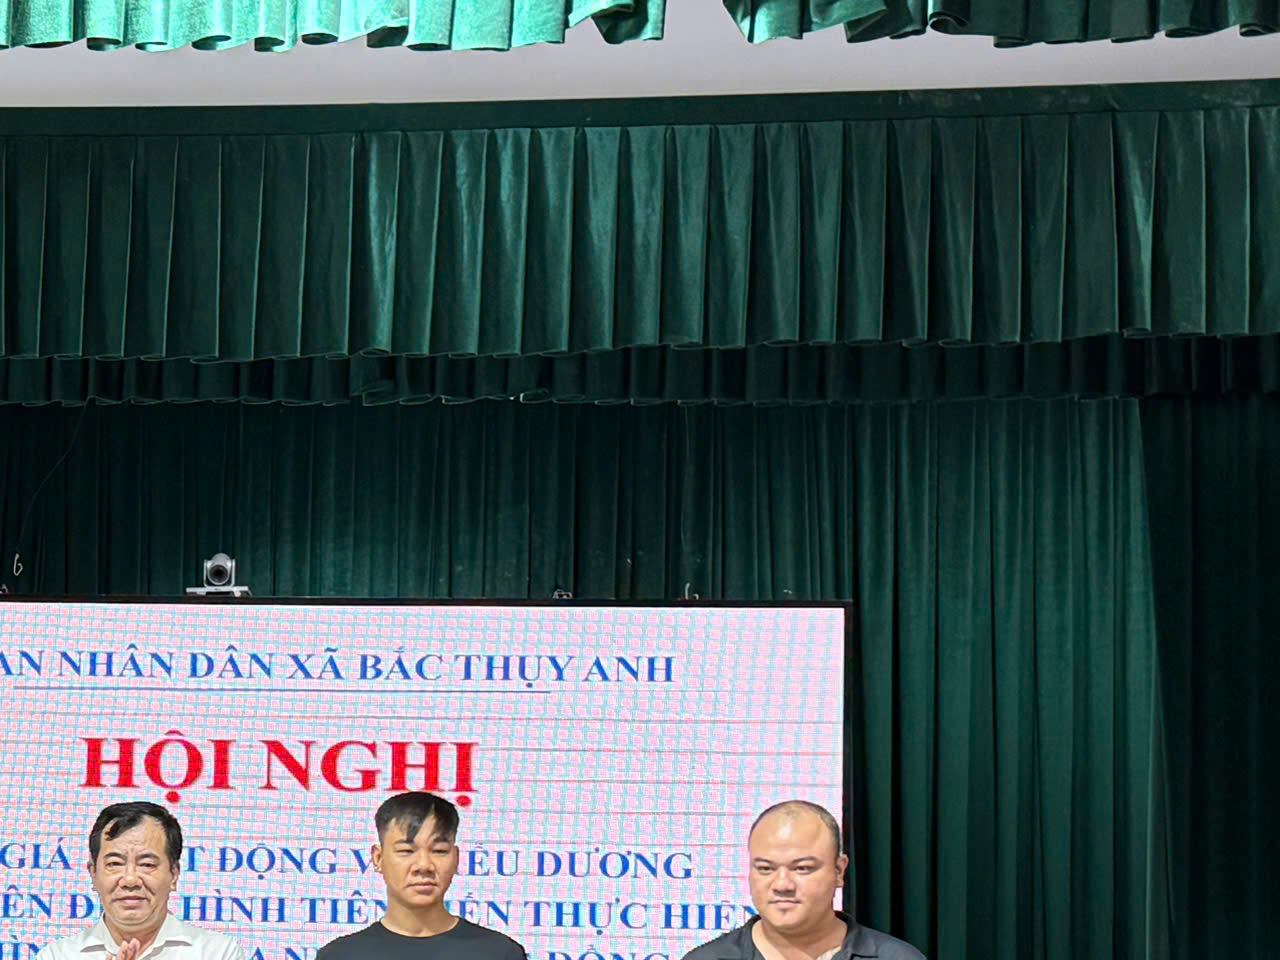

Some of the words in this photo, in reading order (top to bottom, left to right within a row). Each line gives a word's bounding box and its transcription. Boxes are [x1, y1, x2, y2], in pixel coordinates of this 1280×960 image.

[57, 643, 174, 678] NHÂN
[188, 644, 274, 679] DÂN
[287, 648, 345, 680] XÃ
[358, 646, 444, 681] BẮC
[454, 654, 573, 688] THỤY
[582, 656, 676, 682] ANH
[79, 729, 237, 804] HỘI
[260, 740, 479, 807] NGHỊ
[215, 843, 338, 880] ĐỘNG
[536, 847, 693, 880] DƯƠNG
[181, 888, 289, 923] HÌNH
[523, 897, 649, 936] THỰC
